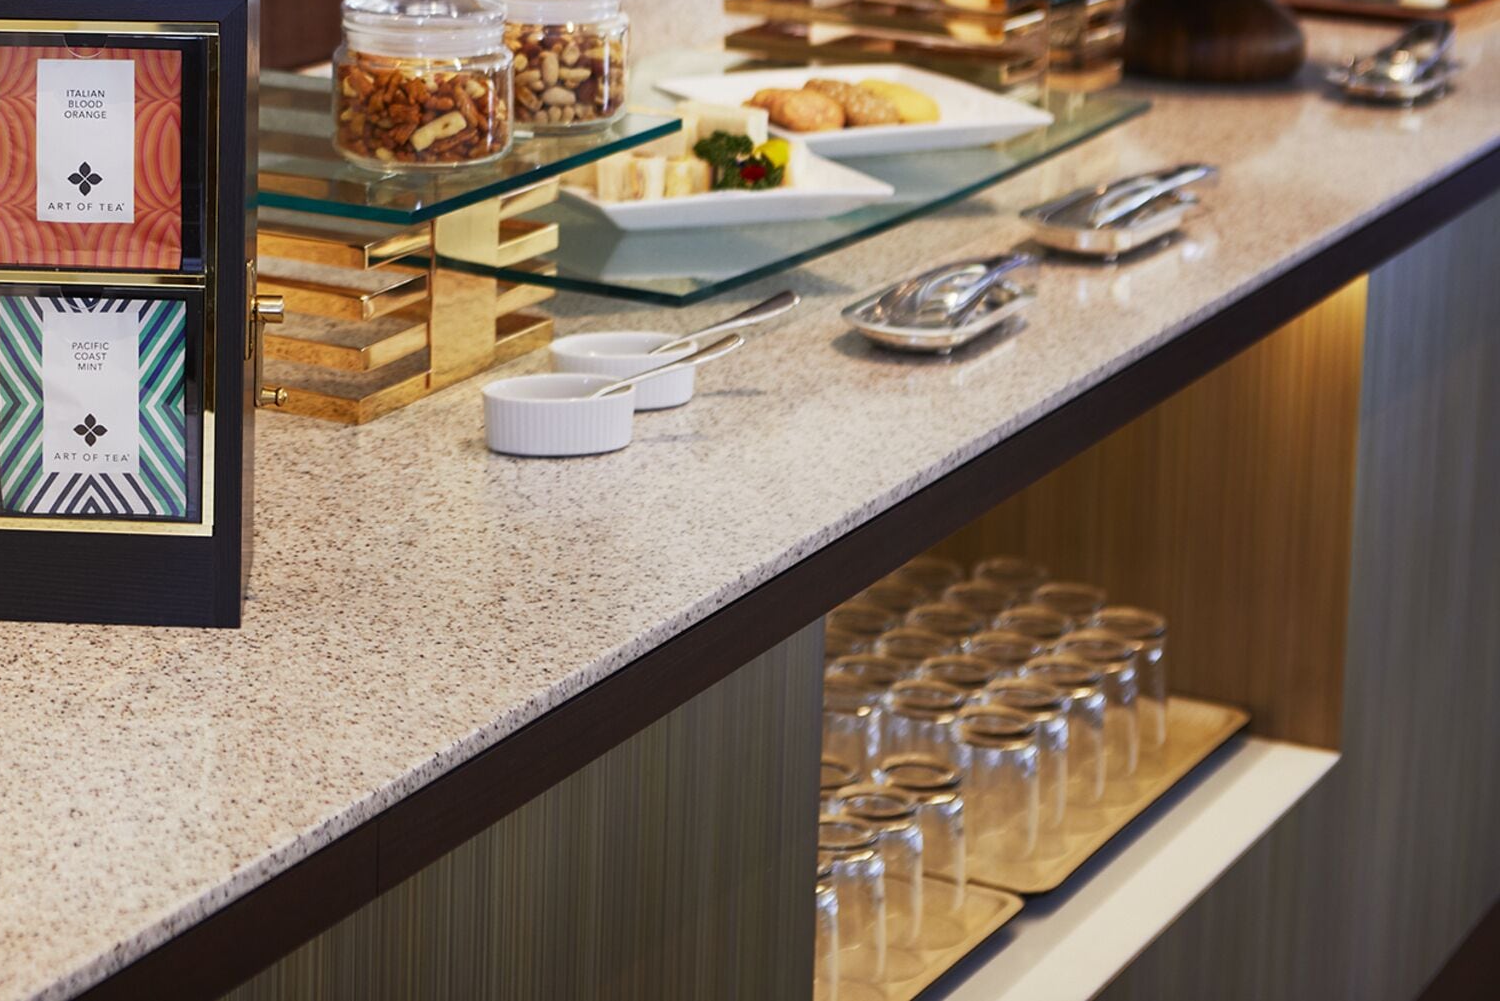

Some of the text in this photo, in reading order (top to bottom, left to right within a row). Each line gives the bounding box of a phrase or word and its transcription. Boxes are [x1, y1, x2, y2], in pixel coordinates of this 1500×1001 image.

[66, 89, 105, 98] ITALIAN
[68, 99, 104, 109] BLOOD
[63, 110, 107, 119] ORANGE
[47, 202, 123, 212] ART OF TEA
[71, 341, 110, 351] PACIFIC
[74, 352, 107, 361] COAST
[77, 362, 103, 371] MINT
[54, 452, 128, 462] ART OF TEA
